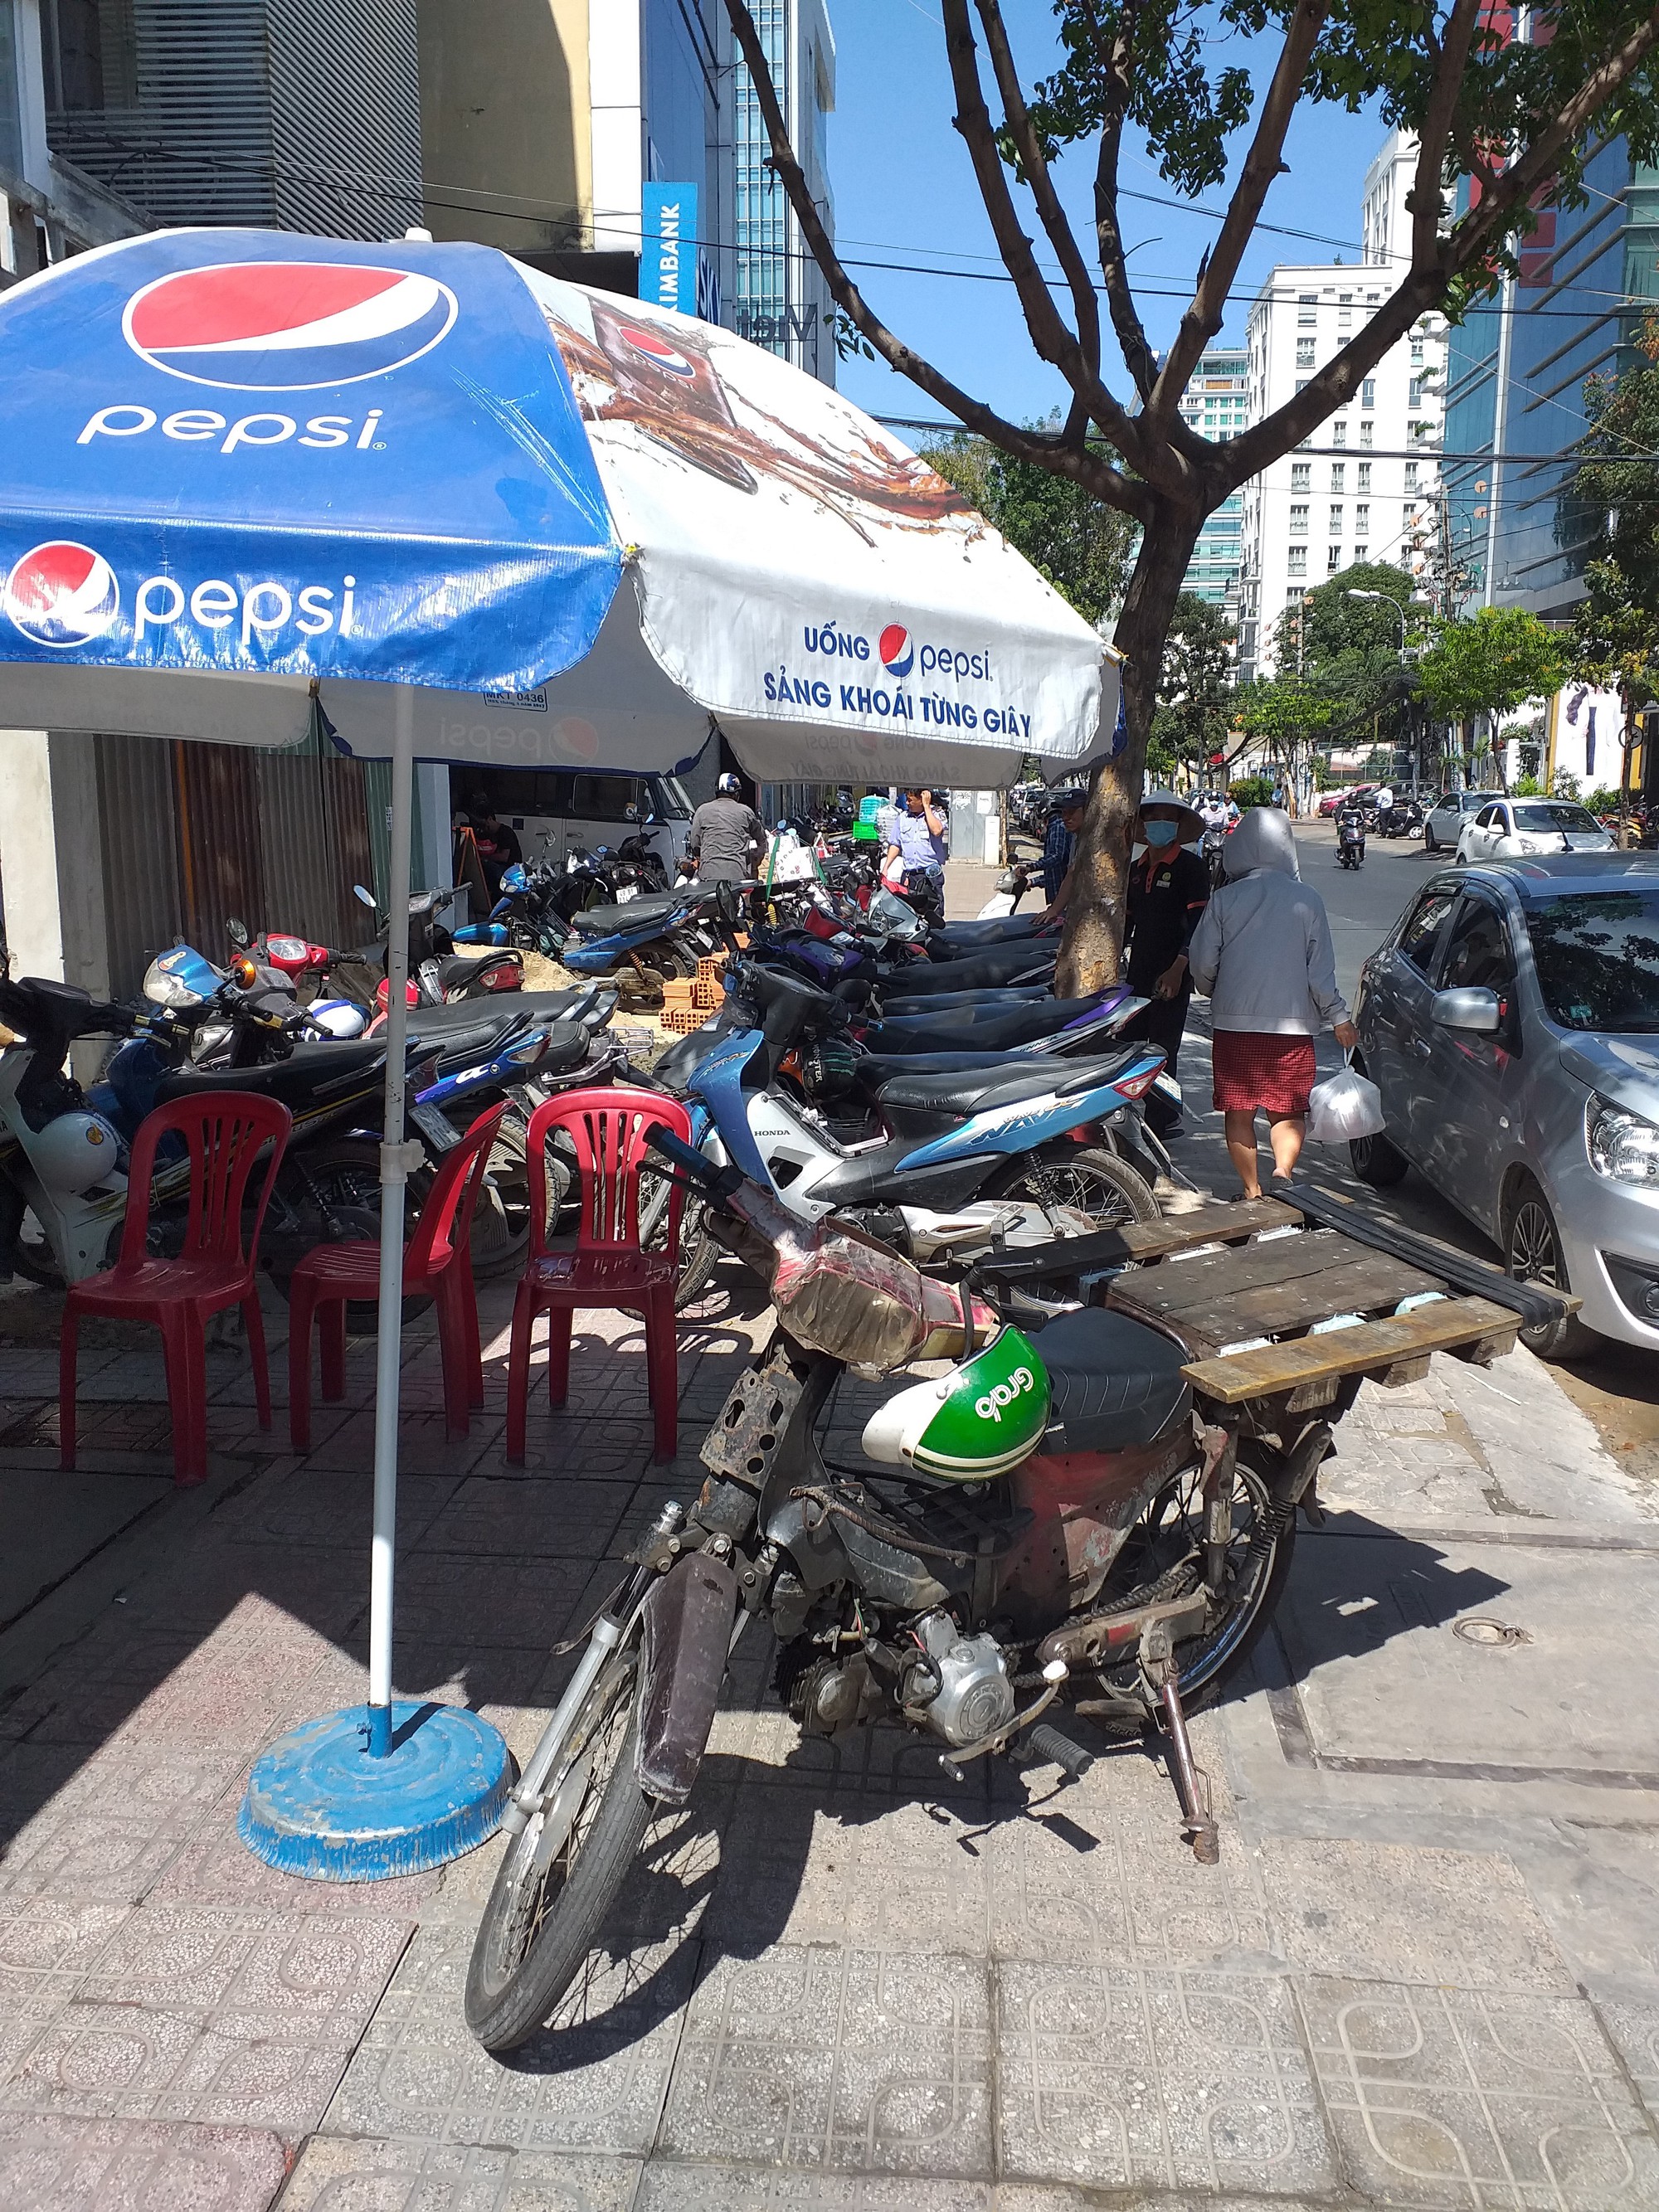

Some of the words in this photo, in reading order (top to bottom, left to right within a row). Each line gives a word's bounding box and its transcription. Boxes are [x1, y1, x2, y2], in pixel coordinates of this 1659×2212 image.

[76, 405, 384, 453] pepsi
[134, 575, 357, 644] pepsi
[804, 620, 870, 661] UỐNG
[920, 644, 990, 683] pepsi
[517, 693, 544, 703] 0436
[763, 665, 831, 707] SẢNG
[839, 687, 913, 720] KHOÁI
[920, 691, 977, 729] TỪNG
[984, 705, 1031, 738] GIÂY
[975, 1366, 1034, 1422] Grab
